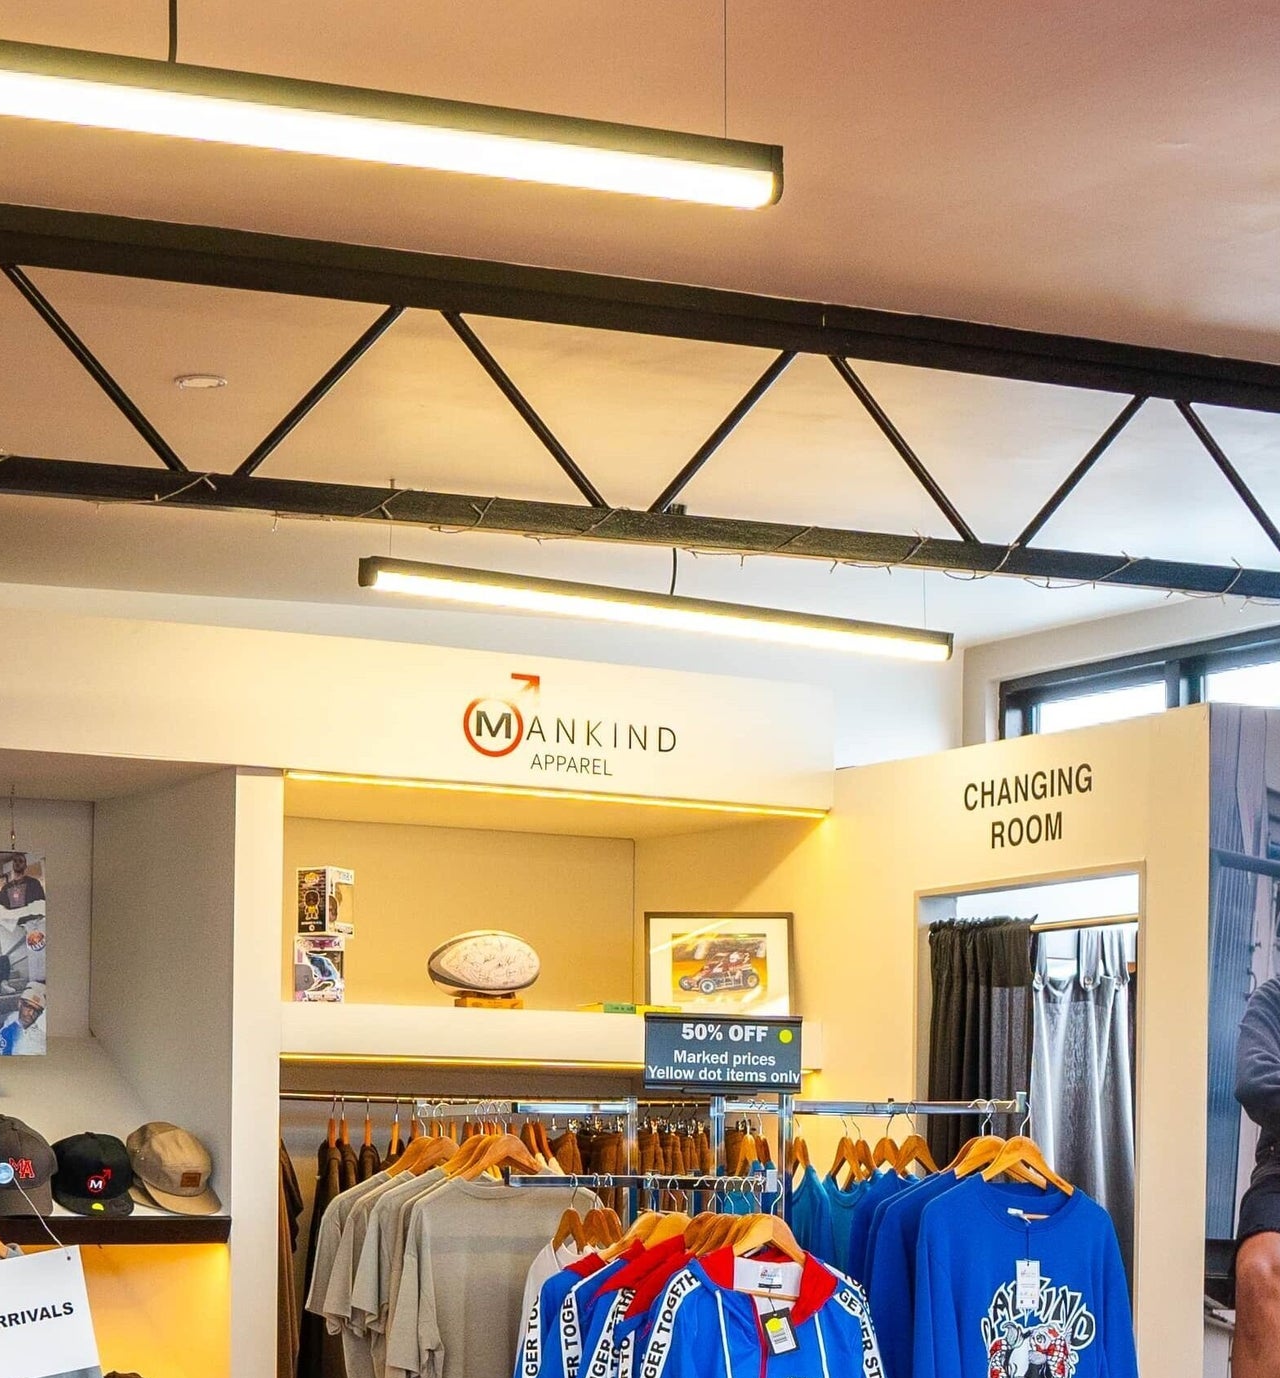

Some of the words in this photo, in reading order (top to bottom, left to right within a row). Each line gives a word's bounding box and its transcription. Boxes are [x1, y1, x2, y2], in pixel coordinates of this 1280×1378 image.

[475, 710, 677, 753] MANKIND
[530, 753, 613, 776] APPAREL
[964, 763, 1093, 811] CHANGING
[991, 811, 1062, 849] ROOM
[681, 1023, 723, 1041] 50%
[728, 1025, 769, 1042] OFF
[674, 1050, 728, 1065] Marked
[732, 1051, 776, 1069] prices
[648, 1065, 695, 1081] Yellow
[698, 1066, 723, 1082] dot
[726, 1067, 767, 1083] items
[770, 1068, 800, 1084] only
